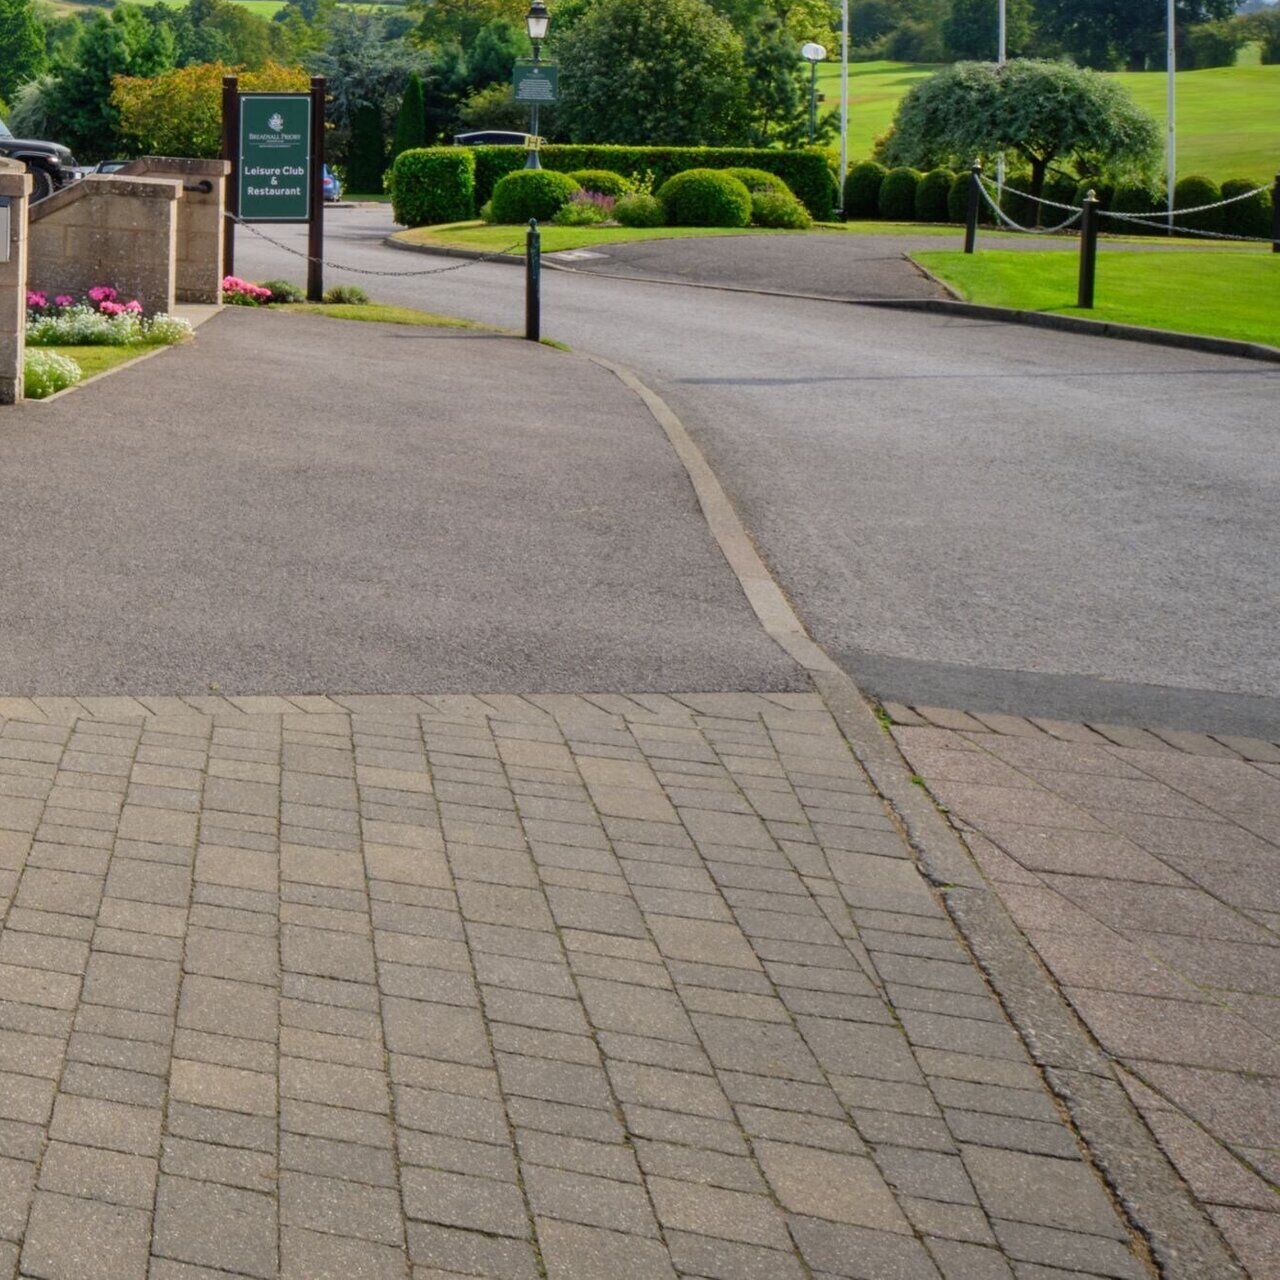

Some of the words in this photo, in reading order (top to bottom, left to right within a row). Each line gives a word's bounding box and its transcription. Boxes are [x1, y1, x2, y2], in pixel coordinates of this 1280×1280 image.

[244, 166, 281, 175] Leisure
[282, 166, 305, 175] Club
[270, 176, 278, 185] &
[247, 187, 301, 195] Restaurant
